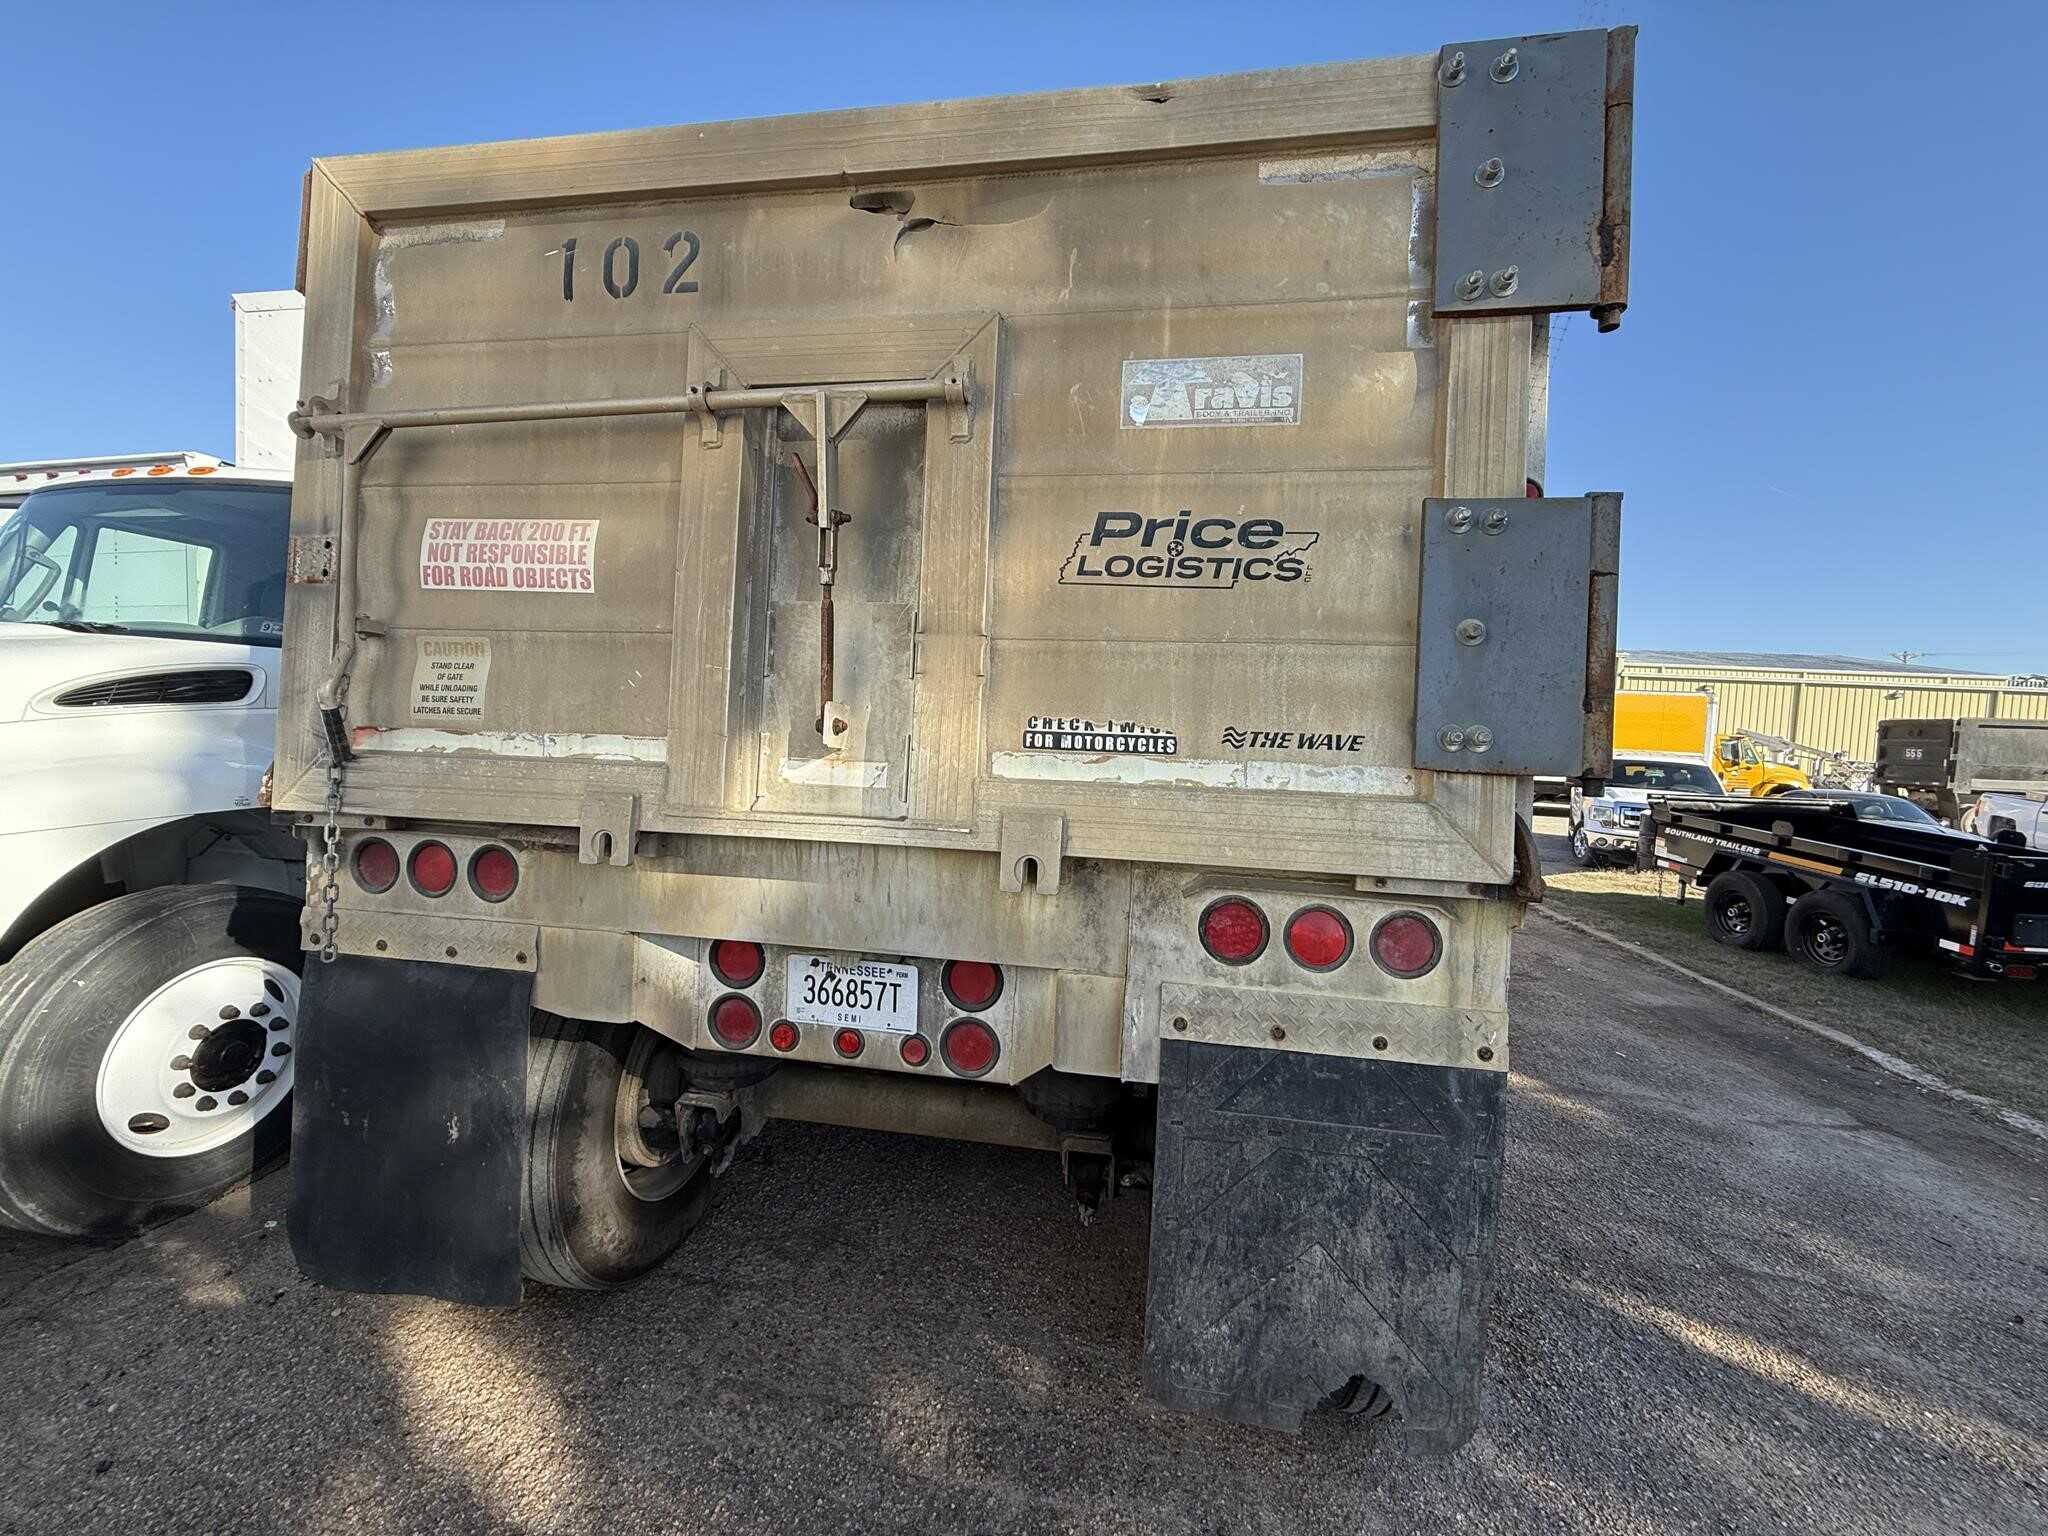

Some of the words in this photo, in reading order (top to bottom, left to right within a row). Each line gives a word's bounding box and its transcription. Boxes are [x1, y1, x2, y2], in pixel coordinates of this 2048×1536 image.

[562, 231, 700, 302] 102
[429, 521, 473, 540] STAY
[474, 522, 528, 541] BACK
[528, 522, 566, 541] 200
[568, 523, 591, 542] FT.
[1090, 510, 1284, 549] Price
[427, 542, 462, 563] NOT
[466, 543, 588, 565] RESPONSIBLE
[423, 565, 455, 586] FOR
[460, 566, 508, 588] ROAD
[512, 566, 592, 590] OBJECTS
[1076, 555, 1304, 582] LOGISTICS
[441, 684, 478, 692] UNLOADING
[413, 706, 441, 714] LATCHES
[456, 707, 482, 715] SECURE
[1028, 716, 1095, 731] CHECK
[1025, 733, 1054, 747] FOR
[1060, 735, 1176, 753] MOTORCYCLES
[1249, 731, 1294, 748] THE
[1297, 733, 1365, 752] WAVE
[1664, 827, 1714, 844] SOUTHLAND
[1715, 838, 1760, 855] TRAILERS
[1854, 871, 1971, 907] SL510-10K
[803, 974, 902, 1013] 366857T
[837, 1013, 862, 1023] SEMI
